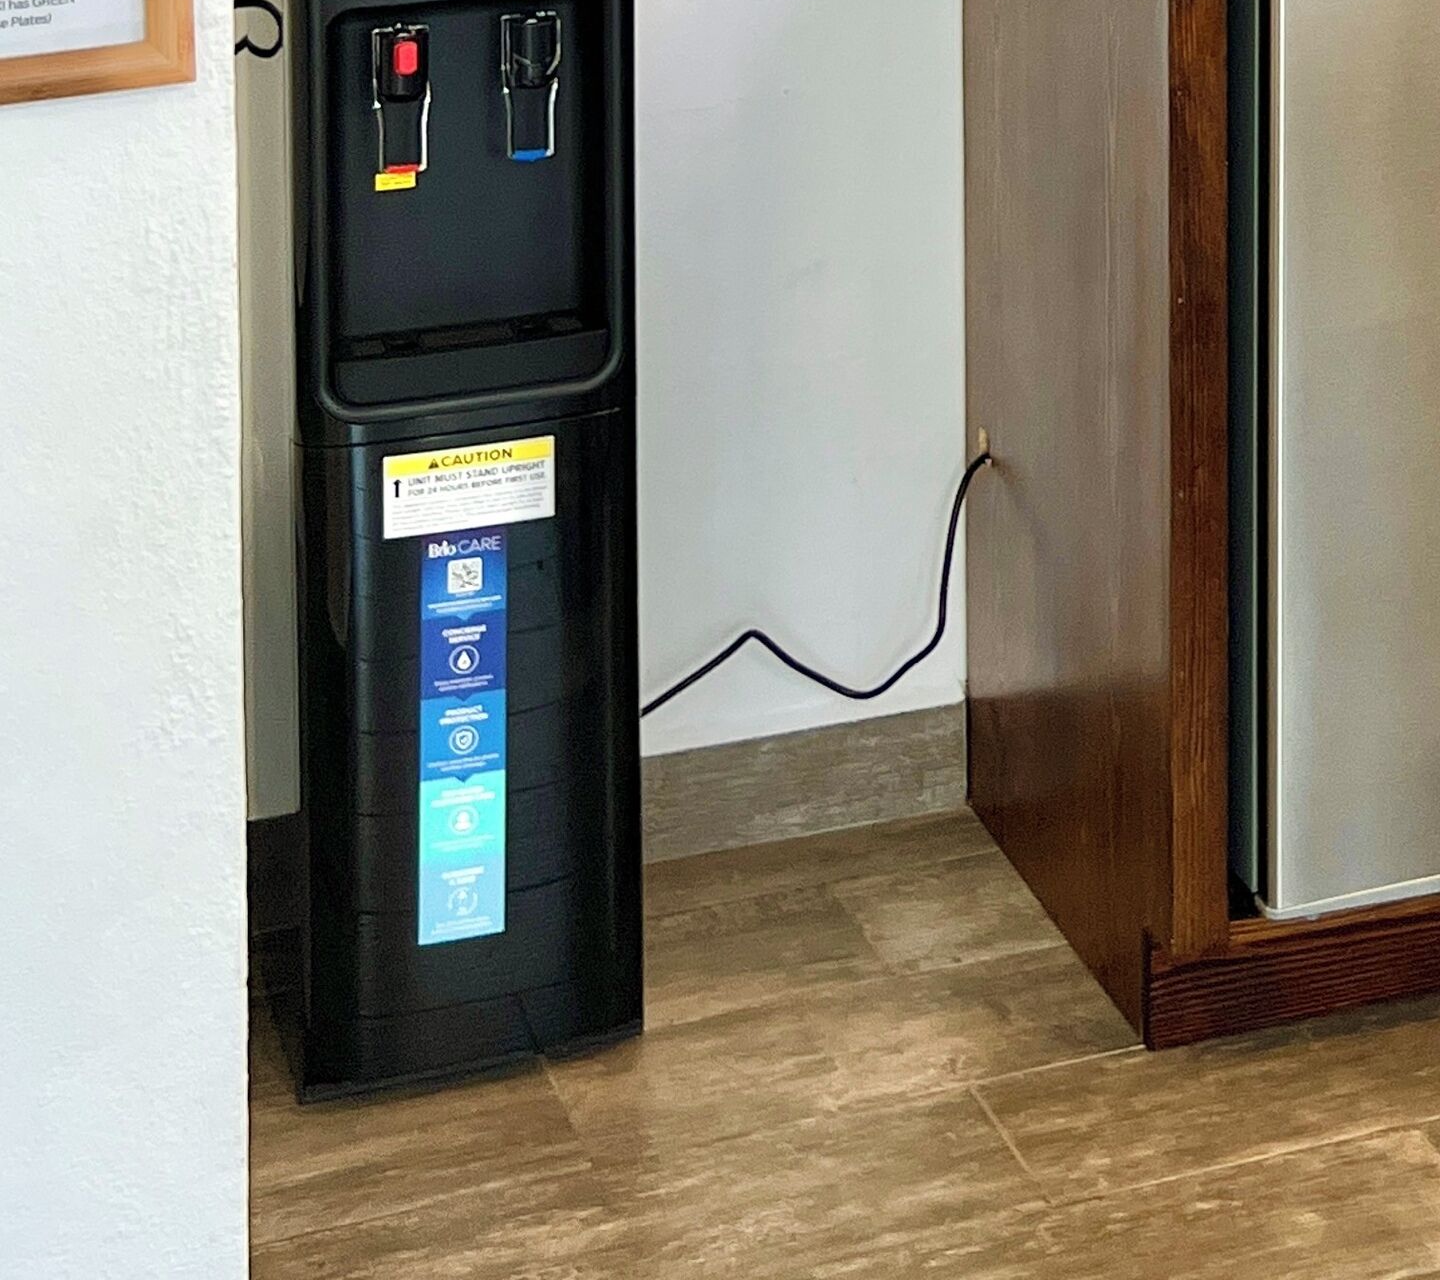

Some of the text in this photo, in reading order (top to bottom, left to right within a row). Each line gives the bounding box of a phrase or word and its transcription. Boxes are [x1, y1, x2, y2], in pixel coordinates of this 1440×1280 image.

[9, 0, 30, 9] has
[440, 448, 513, 467] CAUTION
[434, 471, 463, 482] MUST
[466, 467, 499, 479] STAND
[501, 459, 546, 474] UPRIGHT
